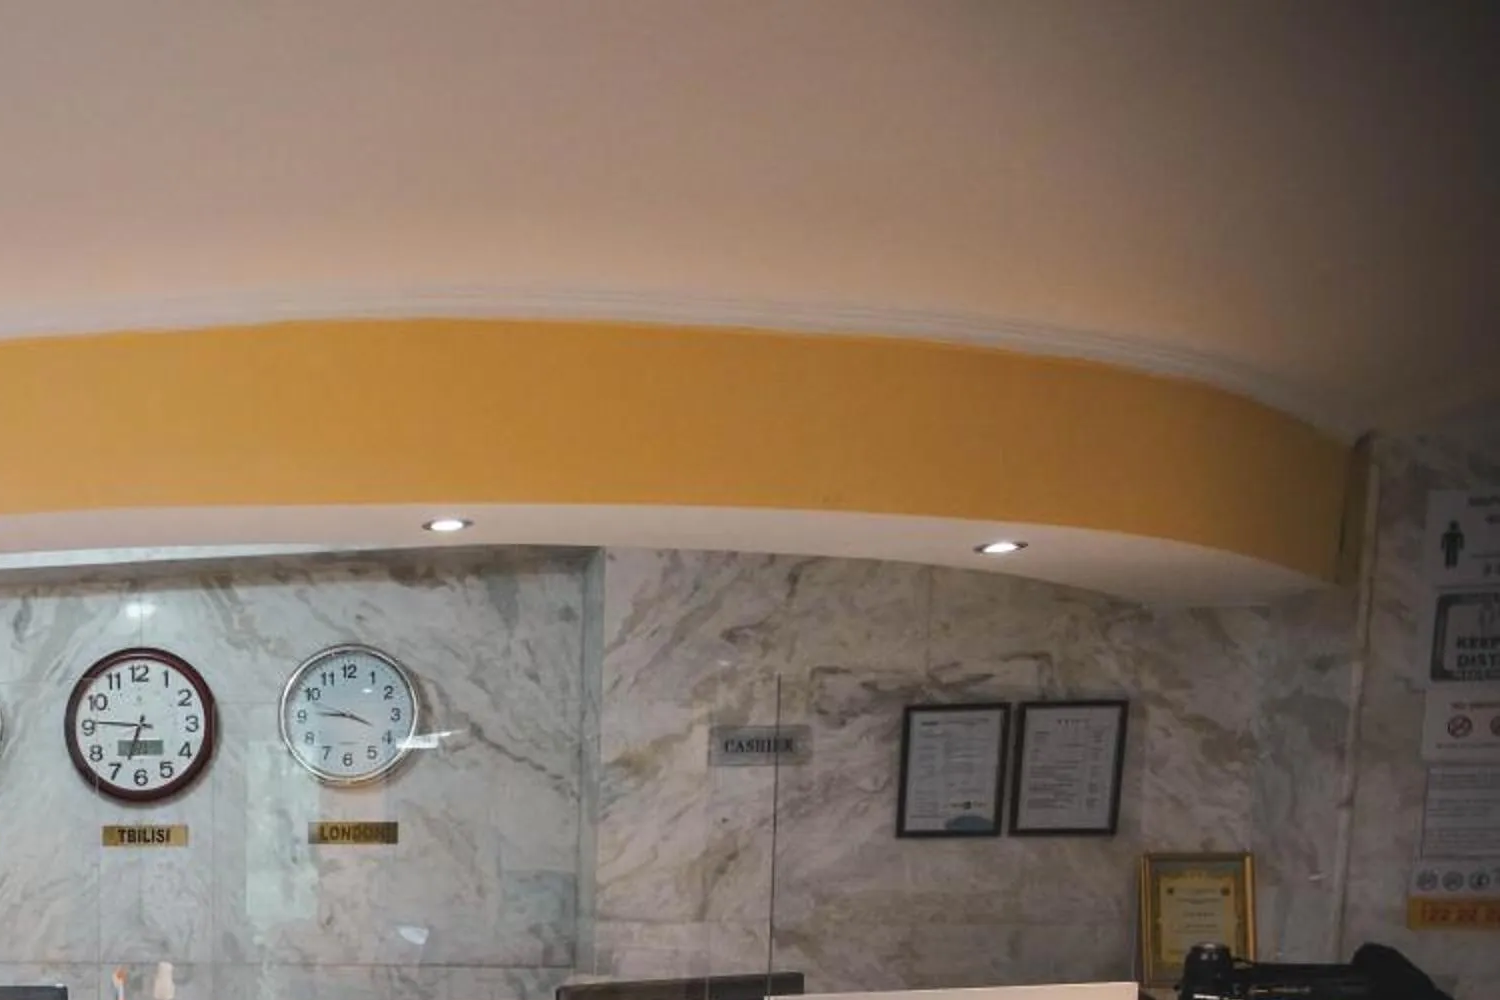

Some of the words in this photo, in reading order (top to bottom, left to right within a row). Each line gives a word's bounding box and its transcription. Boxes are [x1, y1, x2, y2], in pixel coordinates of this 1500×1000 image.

[128, 664, 149, 683] 12
[321, 671, 335, 686] 11
[341, 664, 357, 679] 12
[107, 672, 121, 690] 11
[178, 689, 192, 707] 2
[305, 687, 321, 701] 10
[383, 685, 394, 700] 2
[88, 693, 108, 711] 10
[297, 709, 307, 723] 9
[390, 707, 401, 722] 3
[81, 718, 96, 736] 9
[185, 715, 199, 733] 3
[304, 731, 315, 745] 8
[381, 730, 392, 745] 4
[89, 744, 103, 762] 8
[178, 741, 192, 759] 4
[321, 745, 332, 760] 7
[366, 745, 377, 759] 5
[342, 752, 353, 767] 6
[108, 762, 122, 781] 7
[133, 769, 149, 786] 6
[160, 761, 174, 778] 5
[117, 828, 171, 844] TBILISI
